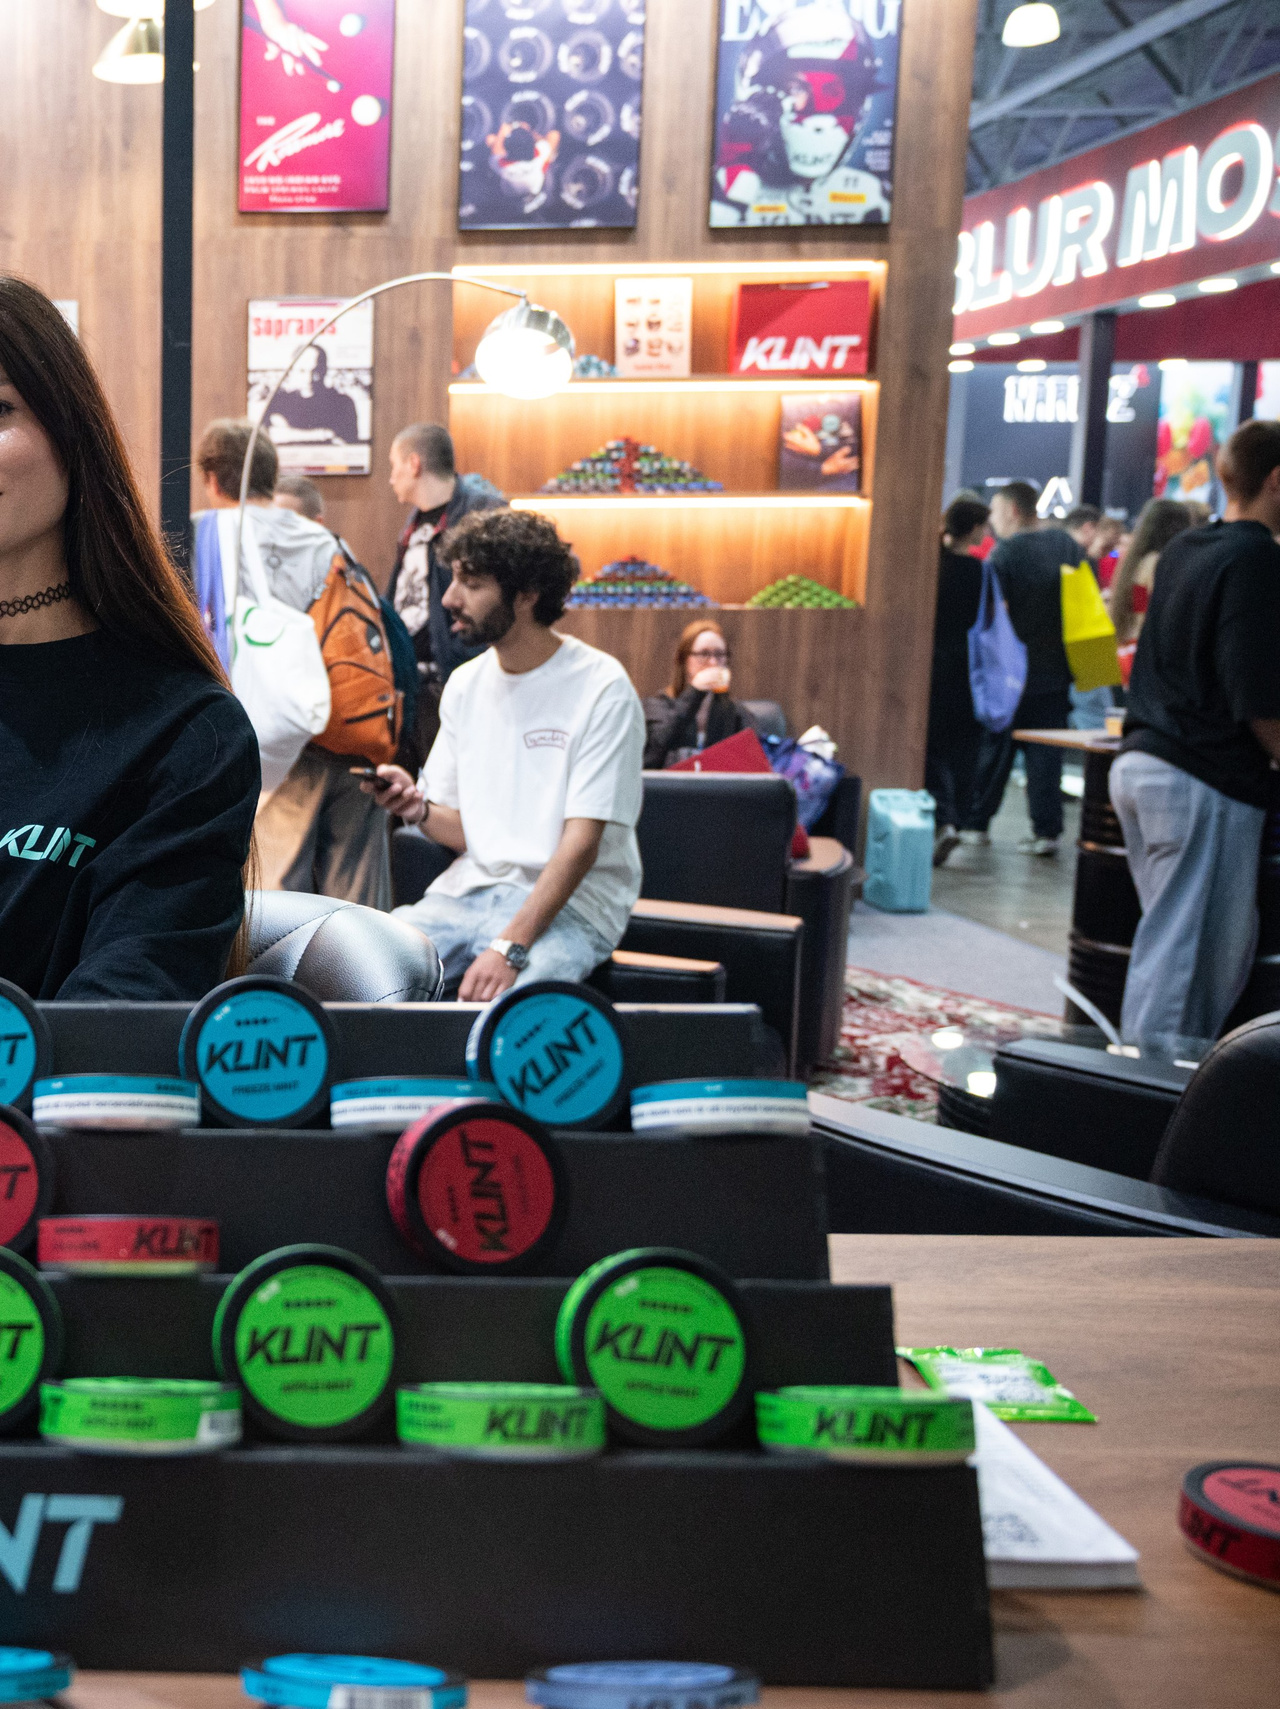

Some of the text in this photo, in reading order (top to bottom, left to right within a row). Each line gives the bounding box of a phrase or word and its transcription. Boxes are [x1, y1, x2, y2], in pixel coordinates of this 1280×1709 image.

[1116, 120, 1280, 268] MO
[740, 334, 862, 371] KLINT
[204, 1033, 318, 1076] KLINT
[509, 1008, 597, 1107] KLINT
[459, 1127, 511, 1252] KLINT
[242, 1322, 381, 1366] KLINT
[593, 1319, 736, 1374] KLINT
[484, 1406, 589, 1440] KLINT
[814, 1407, 937, 1445] KLINT
